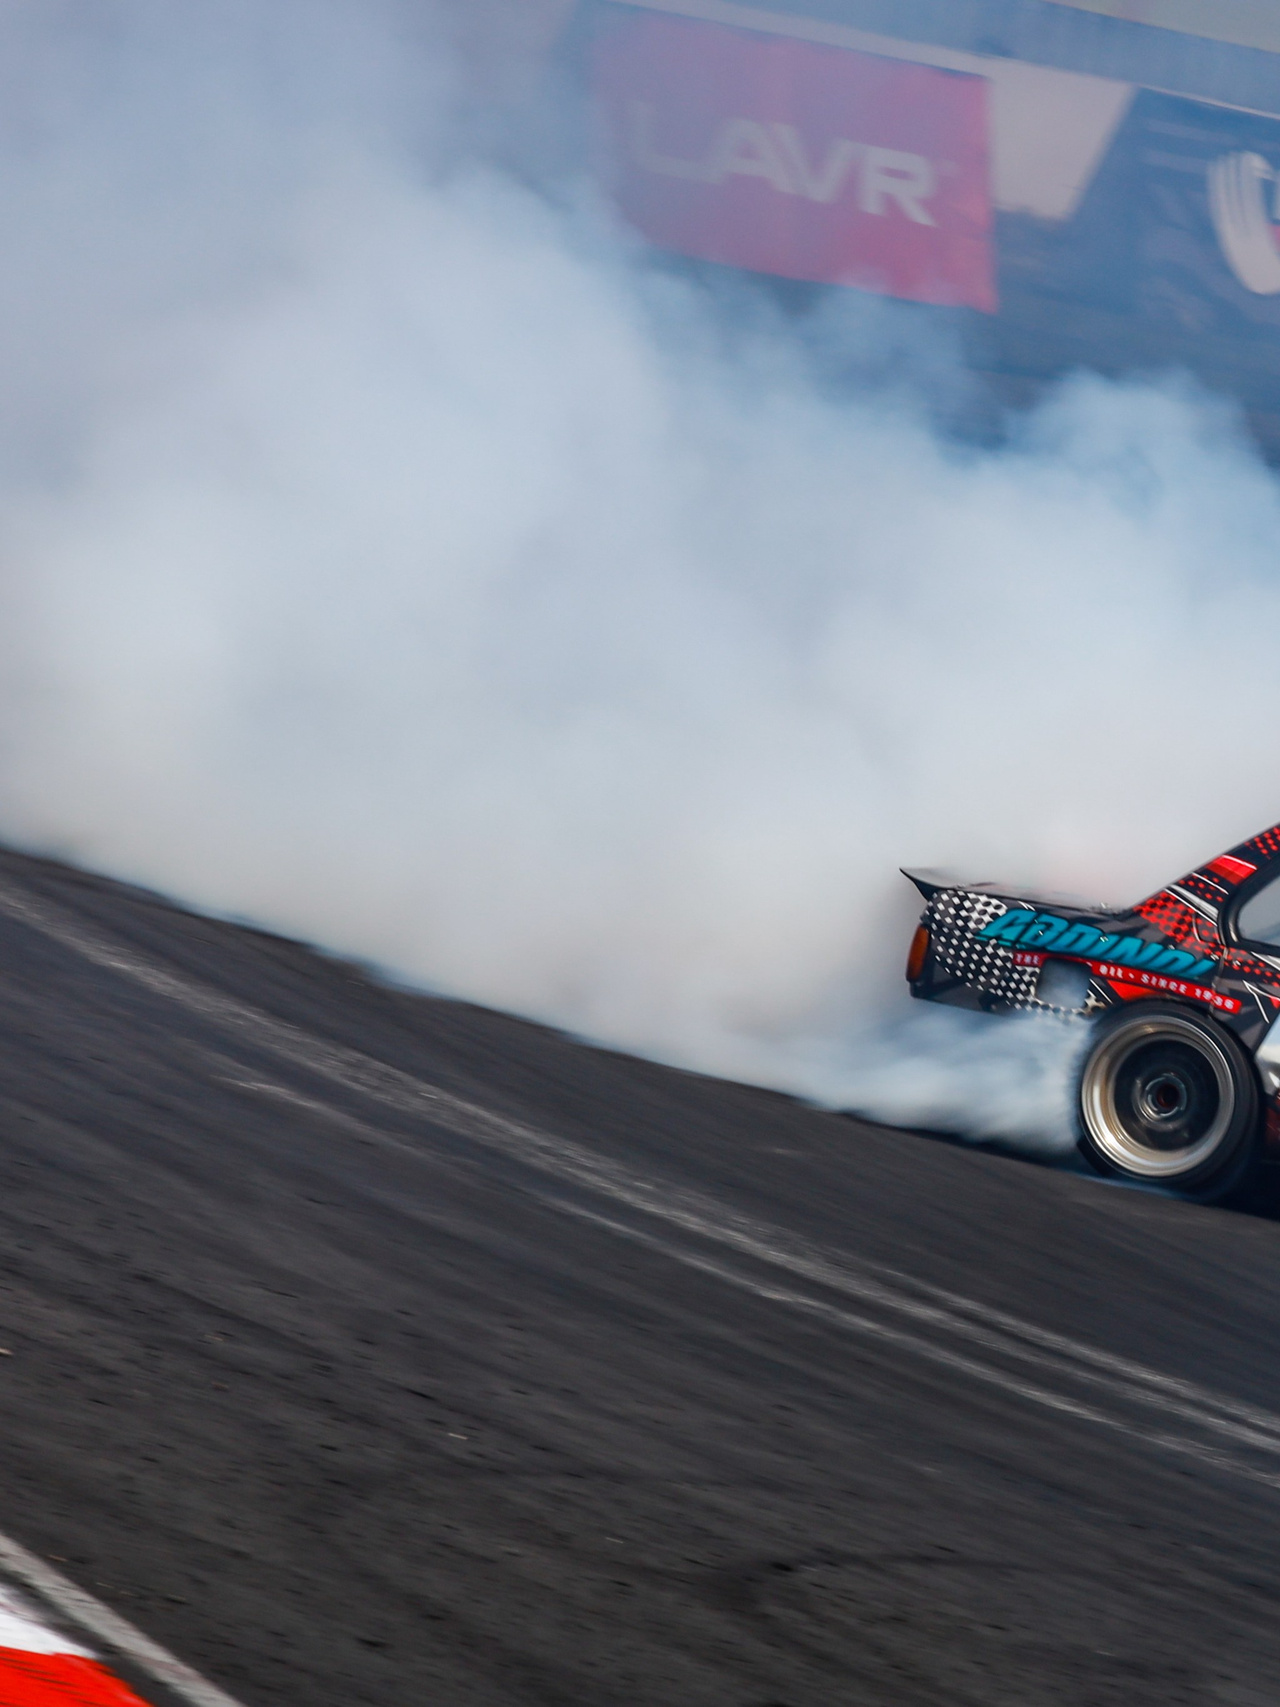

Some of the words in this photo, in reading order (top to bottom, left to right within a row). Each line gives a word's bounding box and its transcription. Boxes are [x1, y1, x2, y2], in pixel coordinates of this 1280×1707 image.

[627, 99, 941, 229] LAVR
[974, 908, 1216, 979] ADDINOL
[1015, 952, 1041, 966] THE
[1099, 965, 1125, 979] OIL
[1140, 973, 1187, 995] SINCE
[1194, 987, 1236, 1011] 1936
